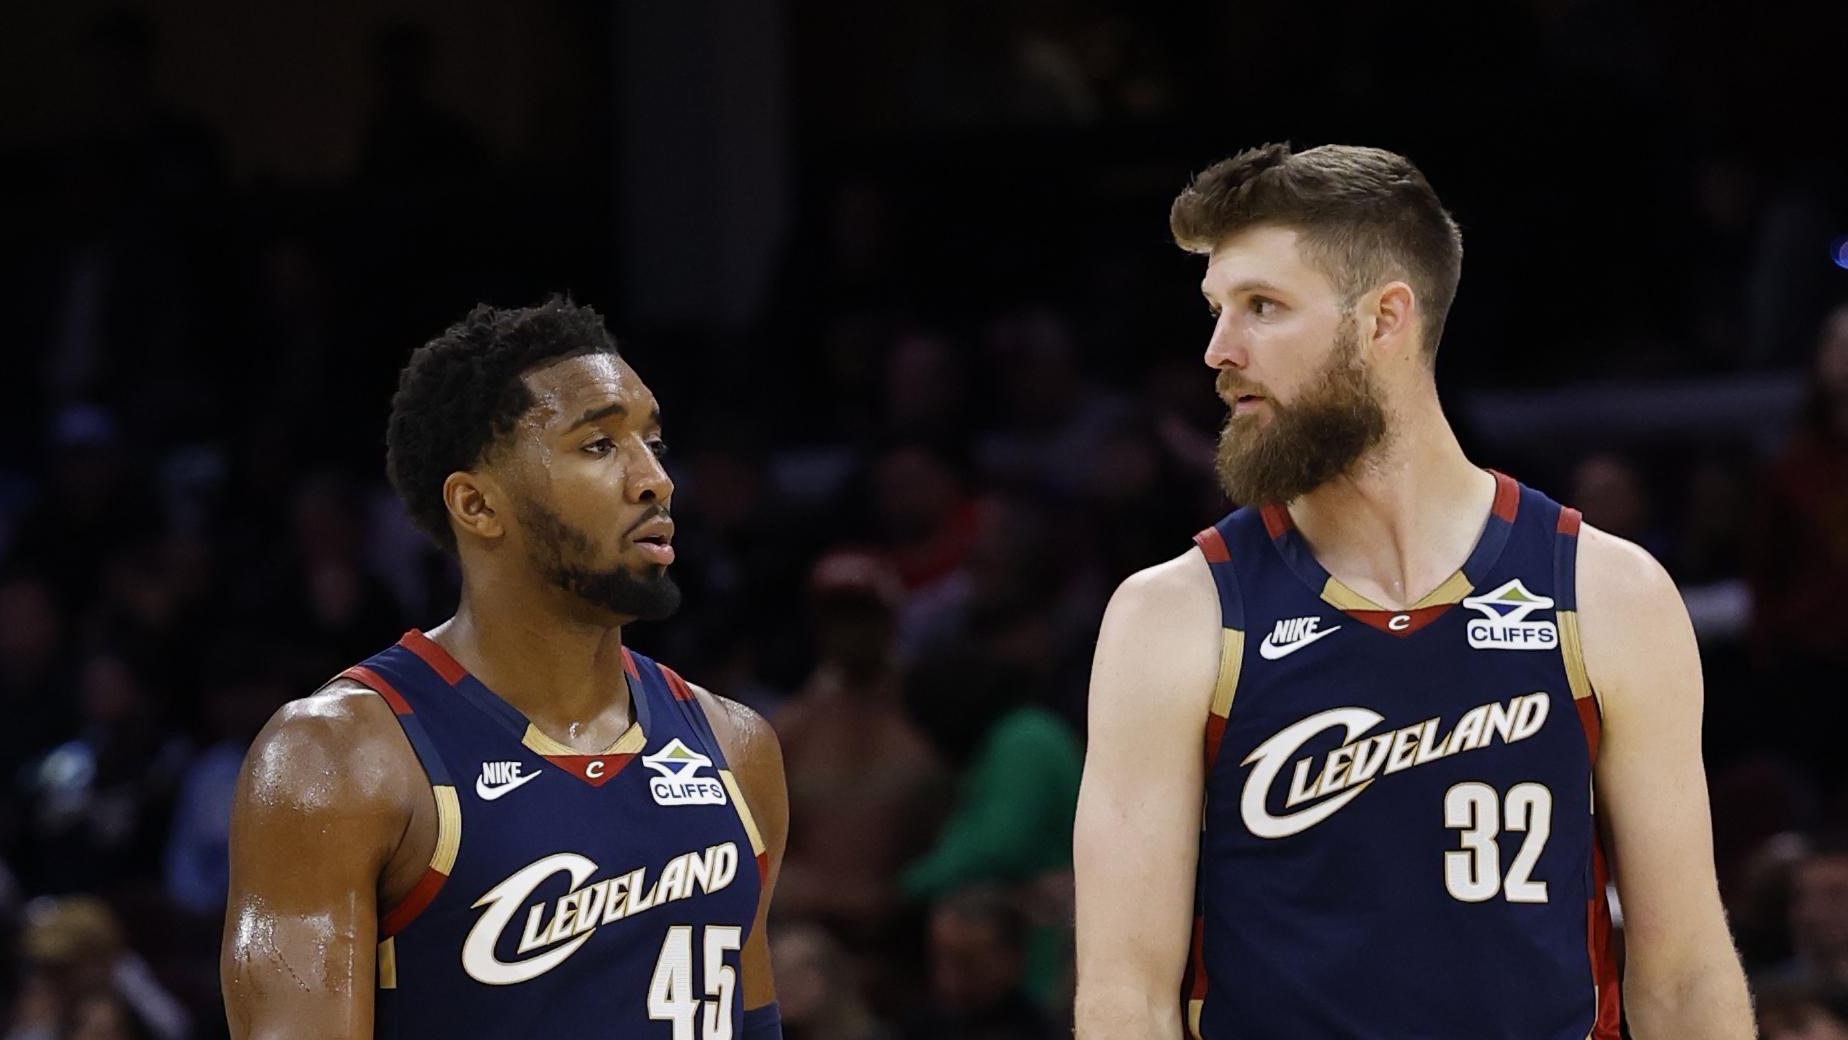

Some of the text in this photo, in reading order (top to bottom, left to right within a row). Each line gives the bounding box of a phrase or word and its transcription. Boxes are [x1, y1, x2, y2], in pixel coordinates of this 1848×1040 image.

[1272, 617, 1320, 643] NIKE
[1389, 615, 1410, 630] C
[1471, 625, 1554, 643] CLIFFS
[482, 761, 523, 784] NIKE
[585, 761, 604, 778] C
[1240, 692, 1551, 839] CLEVELAND
[654, 783, 723, 800] CLIFFS
[1444, 781, 1552, 903] 32
[462, 842, 738, 985] CLEVELAND
